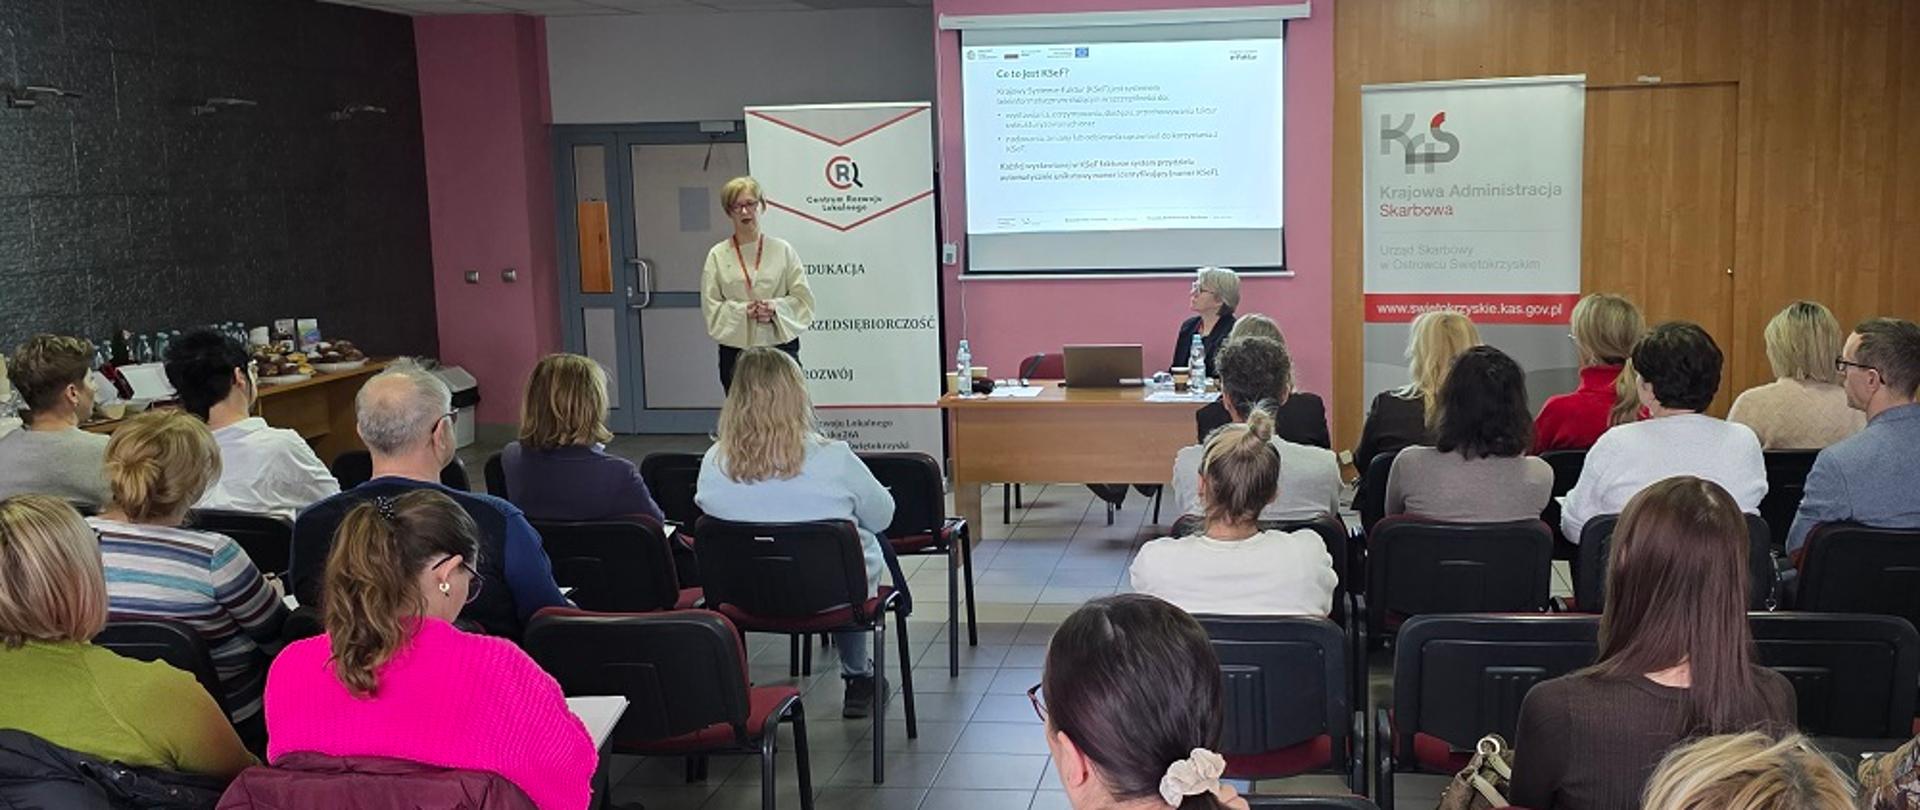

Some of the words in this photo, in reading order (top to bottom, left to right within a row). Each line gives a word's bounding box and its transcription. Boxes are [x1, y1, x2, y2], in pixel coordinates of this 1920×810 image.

[996, 69, 1010, 78] Co
[1012, 69, 1022, 78] to
[1041, 67, 1070, 78] KSeF?
[1379, 185, 1445, 201] Krajowa
[1450, 182, 1562, 199] Administracja
[806, 196, 843, 204] Centrum
[846, 195, 883, 204] Rozwoju
[822, 203, 867, 213] Lokalnego
[1379, 203, 1454, 218] Skarbowa
[1380, 243, 1415, 256] Urząd
[1417, 243, 1474, 257] Skarbowy
[1380, 261, 1389, 270] w
[1392, 258, 1447, 270] Ostrowcu
[808, 315, 935, 333] RZEDSIĘBIORCZOŚĆ
